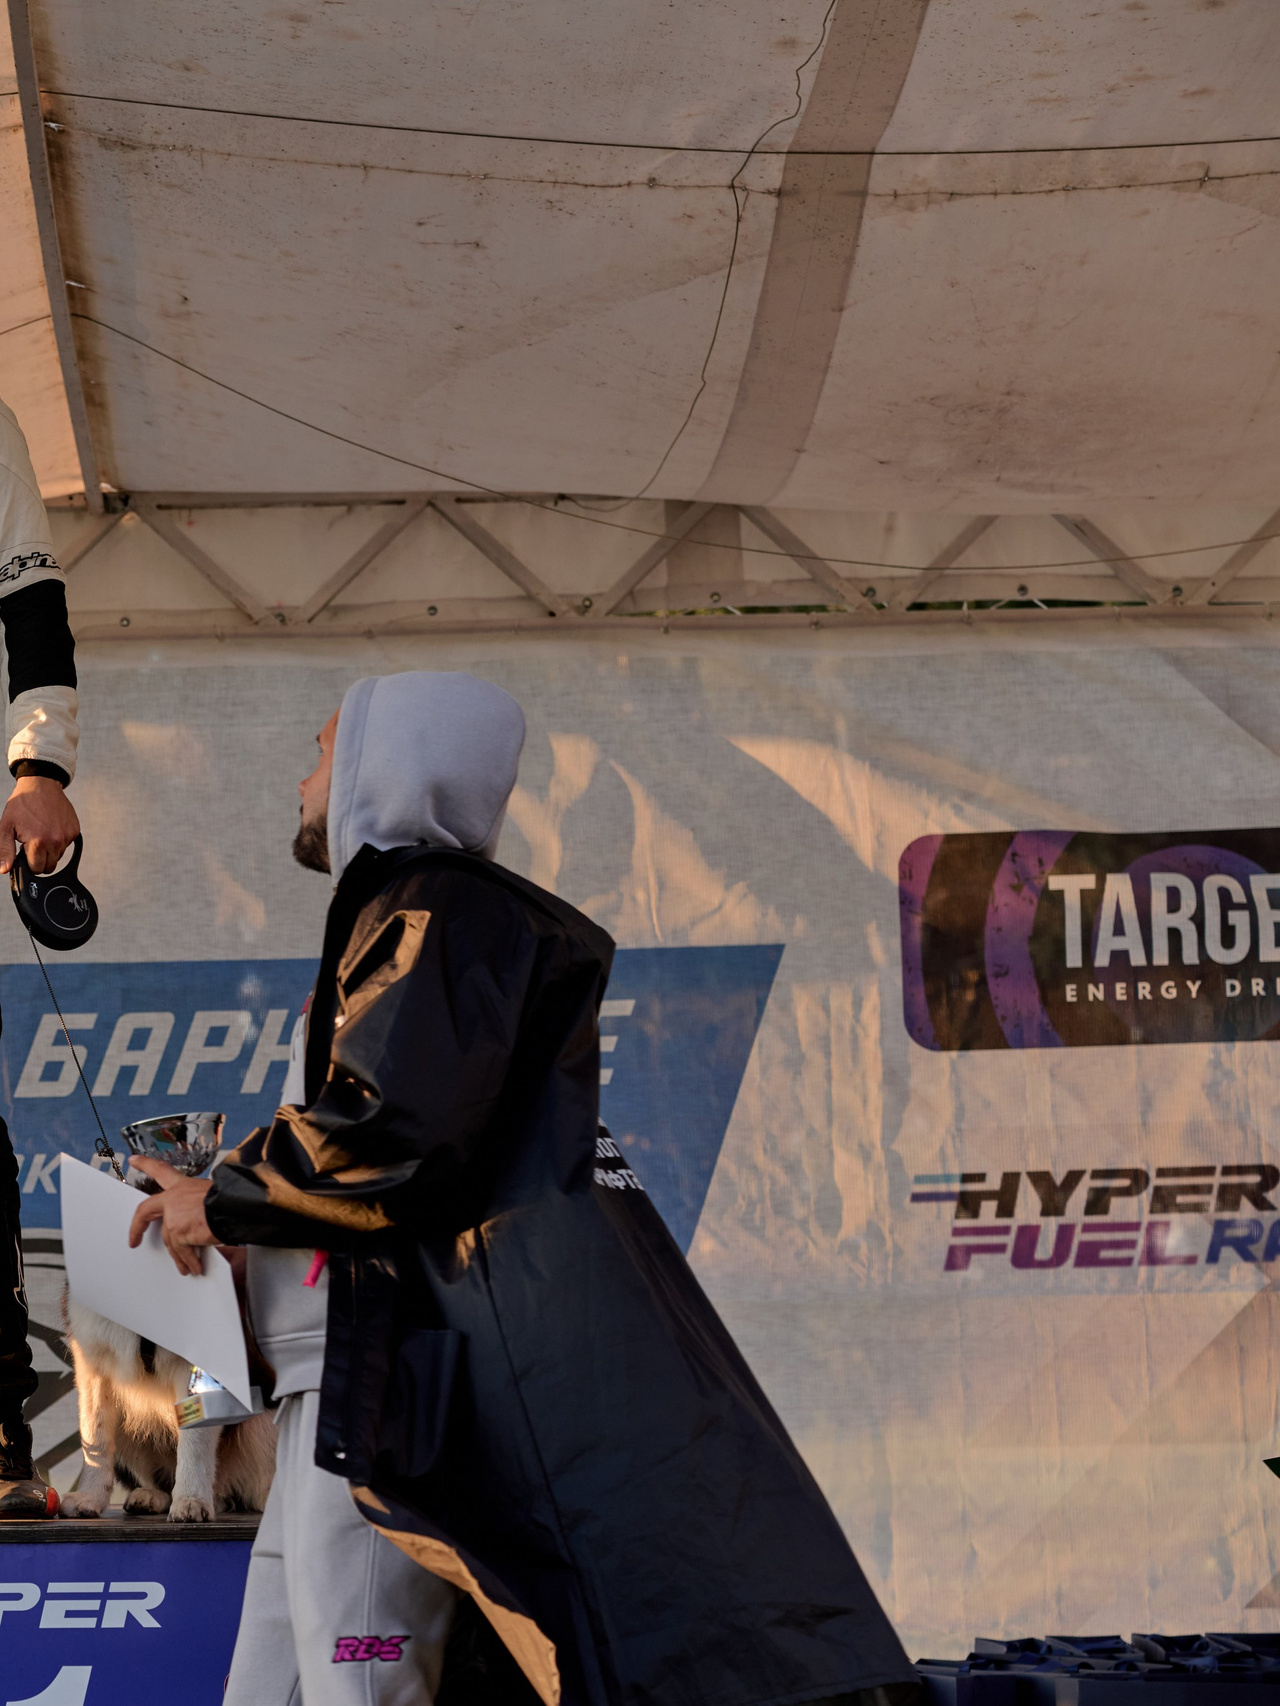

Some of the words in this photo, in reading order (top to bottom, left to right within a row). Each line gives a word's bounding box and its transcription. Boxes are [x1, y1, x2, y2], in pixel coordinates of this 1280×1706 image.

[1065, 979, 1201, 1002] ENERGY
[910, 1164, 1280, 1219] HYPER
[332, 1635, 411, 1664] RDS
